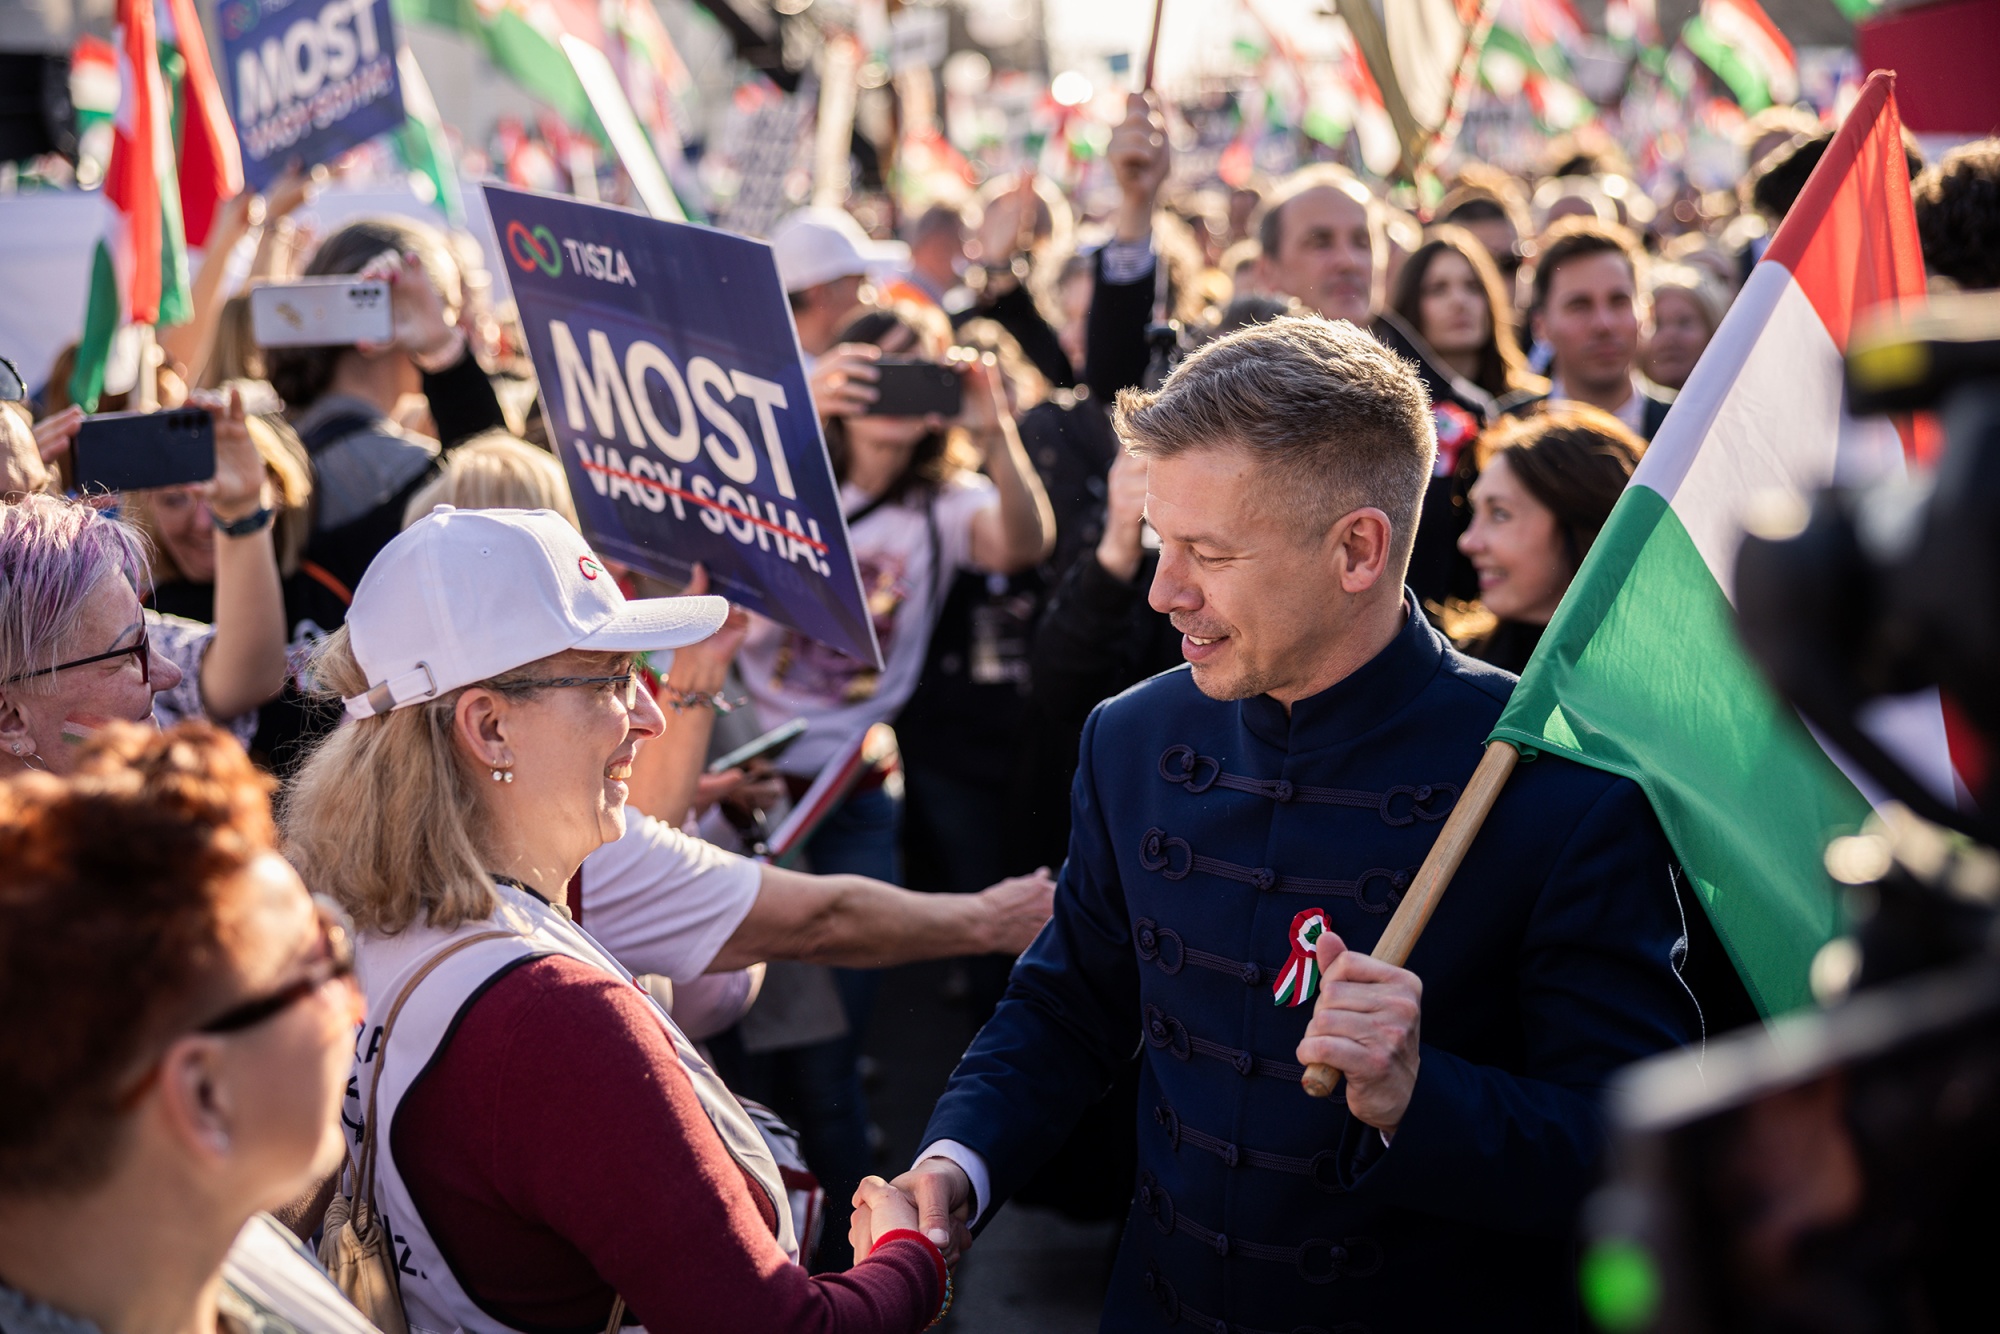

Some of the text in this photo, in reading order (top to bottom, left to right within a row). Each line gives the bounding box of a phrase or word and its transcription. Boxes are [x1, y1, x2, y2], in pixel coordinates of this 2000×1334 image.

[237, 0, 382, 127] MOST
[562, 237, 637, 288] TISZA
[549, 319, 796, 500] MOST
[574, 438, 687, 521] VAGY
[690, 474, 832, 578] SOHA!
